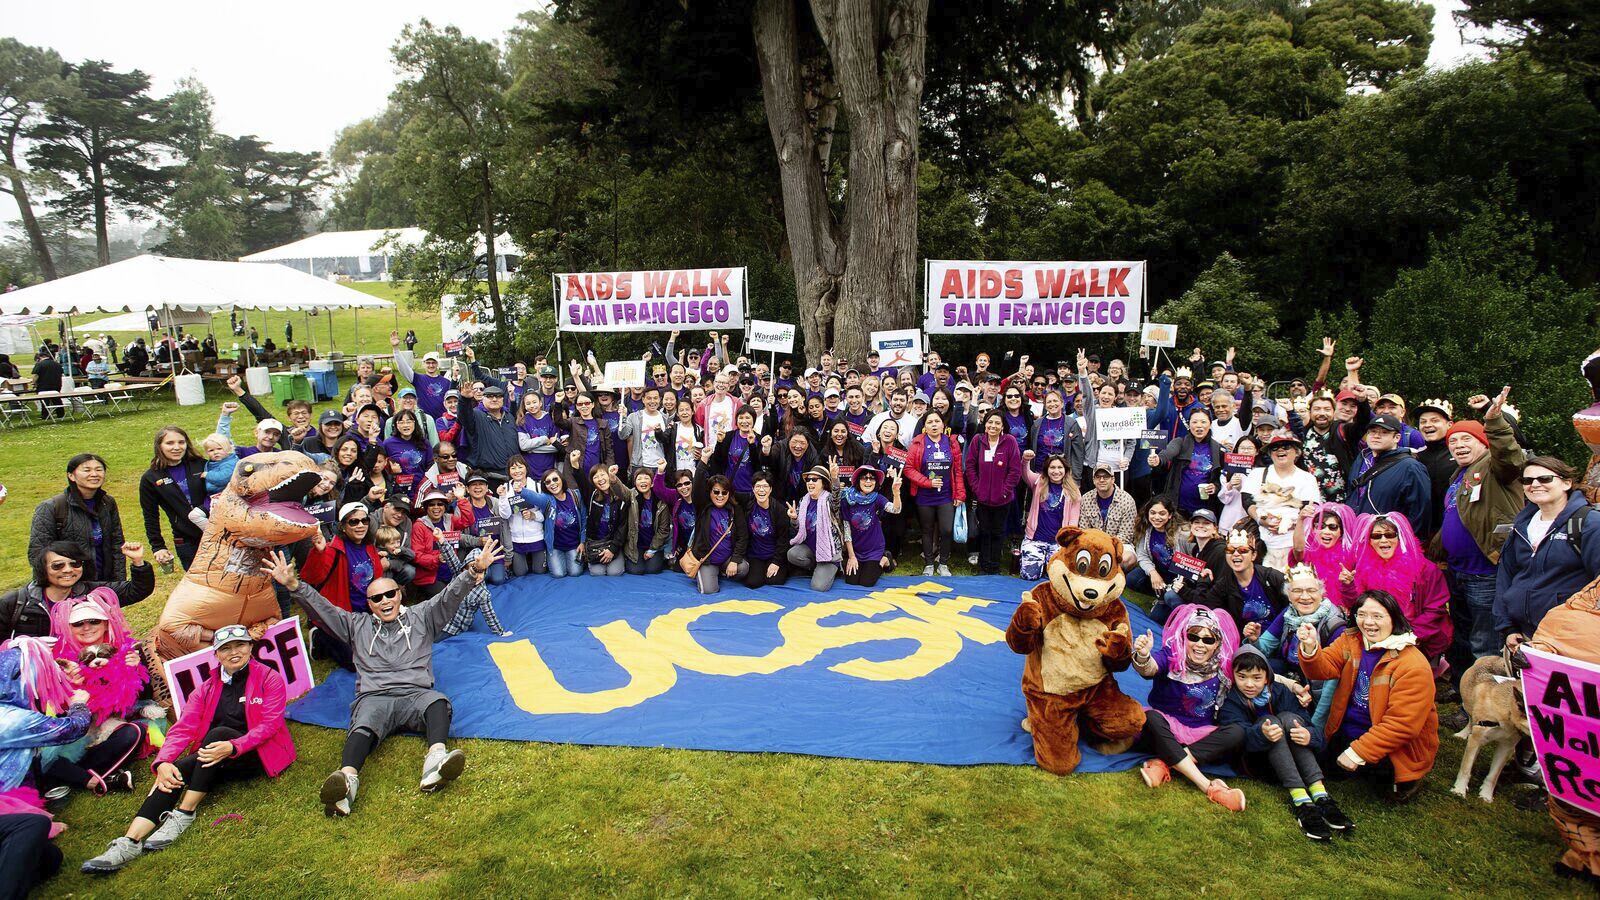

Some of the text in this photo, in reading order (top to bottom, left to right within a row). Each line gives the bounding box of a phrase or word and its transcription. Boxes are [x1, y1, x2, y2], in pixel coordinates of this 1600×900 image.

[566, 268, 732, 301] AIDS WALK
[940, 267, 1132, 299] AIDS WALK
[568, 299, 729, 326] SAN FRANCISCO
[943, 300, 1126, 327] SAN FRANCISCO
[755, 332, 784, 342] Ward86
[1101, 420, 1135, 428] Ward86
[1176, 553, 1195, 564] Support
[487, 581, 1007, 715] UCSF
